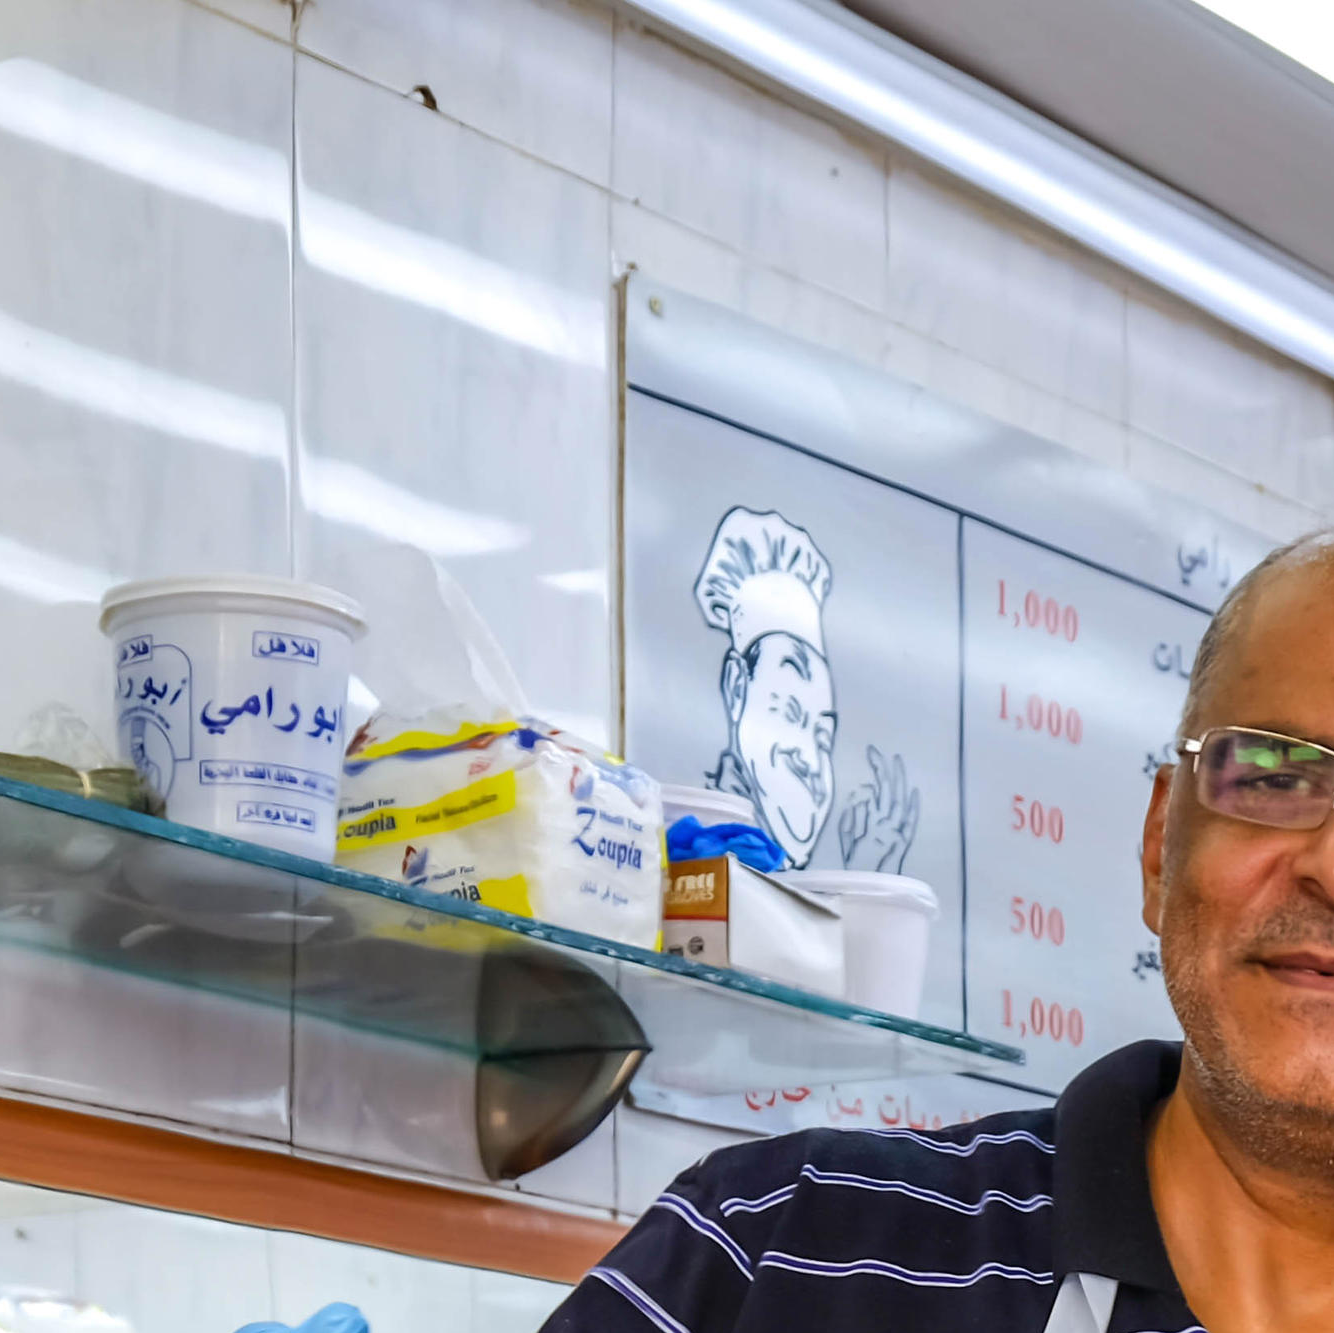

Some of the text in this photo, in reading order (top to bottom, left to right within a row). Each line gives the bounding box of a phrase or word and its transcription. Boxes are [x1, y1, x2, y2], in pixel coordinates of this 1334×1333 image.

[997, 579, 1078, 642] 1,000
[258, 636, 316, 659] فلافل
[199, 685, 301, 736] رامي
[998, 683, 1083, 744] 1,000
[336, 814, 397, 841] oupia
[571, 805, 643, 870] Zoupia
[1012, 794, 1064, 845] 500
[1011, 896, 1065, 947] 500
[1002, 988, 1085, 1048] 1,000
